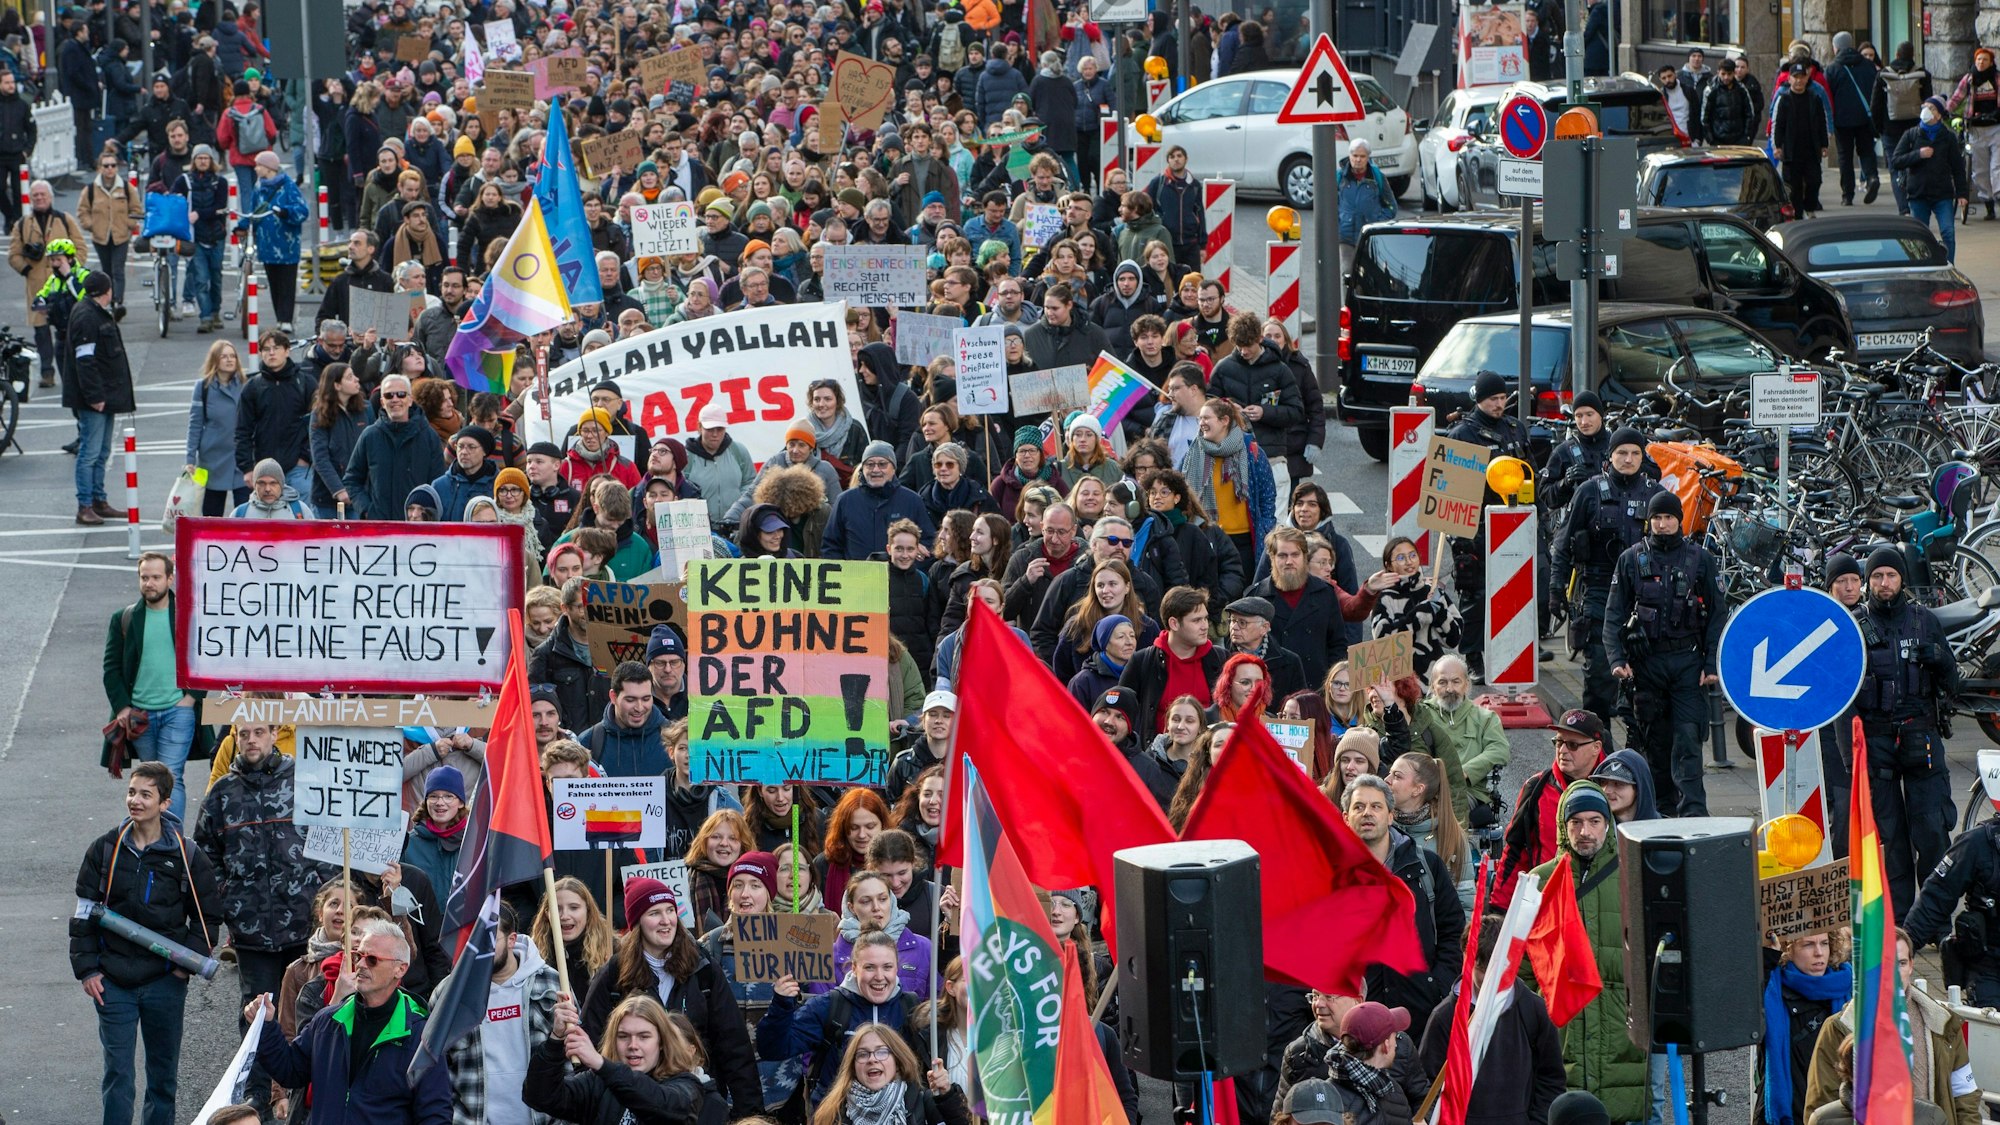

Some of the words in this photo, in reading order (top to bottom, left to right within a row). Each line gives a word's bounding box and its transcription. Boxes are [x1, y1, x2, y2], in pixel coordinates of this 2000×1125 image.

[841, 83, 866, 96] KEINE
[848, 69, 871, 84] HASS
[876, 80, 891, 90] IST
[1504, 174, 1541, 184] Seitenstreifen
[647, 218, 687, 230] WIEDER
[658, 229, 674, 241] IST
[648, 239, 683, 253] JETZT
[825, 258, 926, 270] MENSCHENRECHTE
[833, 281, 879, 292] RECHTE
[860, 292, 916, 304] MENSCHEN
[682, 321, 839, 360] YALLAH
[1888, 333, 1914, 344] 2479
[1379, 361, 1390, 370] HK
[1392, 361, 1414, 371] 1997
[622, 374, 795, 440] AZIS
[1429, 467, 1448, 491] Für
[1424, 495, 1479, 527] DUMME
[206, 543, 279, 573] DAS
[303, 543, 438, 577] EINZIG
[700, 562, 844, 606] KEINE
[202, 581, 339, 620] LEGITIME
[353, 583, 467, 620] RECHTE
[587, 583, 650, 608] AFD?
[587, 604, 649, 625] NEIN!
[700, 607, 871, 655] BÜHNE
[1354, 634, 1407, 671] NAZIS
[698, 654, 789, 697] DER
[230, 700, 369, 724] ANTI-ANTIFA
[398, 700, 438, 726] FA
[701, 696, 812, 741] AFD
[303, 735, 343, 761] NIE
[346, 739, 403, 767] WIEDER
[704, 748, 761, 783] NIE
[775, 746, 889, 784] WIEDER
[332, 766, 371, 787] IST
[303, 786, 398, 818] JETZT
[307, 840, 329, 852] DEN
[311, 831, 342, 845] IHNEN
[354, 831, 385, 843] STATT
[626, 866, 685, 880] PROTECT
[1767, 909, 1803, 927] IHNEN
[1768, 901, 1792, 915] MAN
[737, 914, 778, 941] KEIN
[1765, 915, 1835, 940] GESCHICHTE
[784, 951, 833, 980] NAZIS
[490, 1007, 519, 1020] PEACE
[1030, 970, 1062, 1050] FOR
